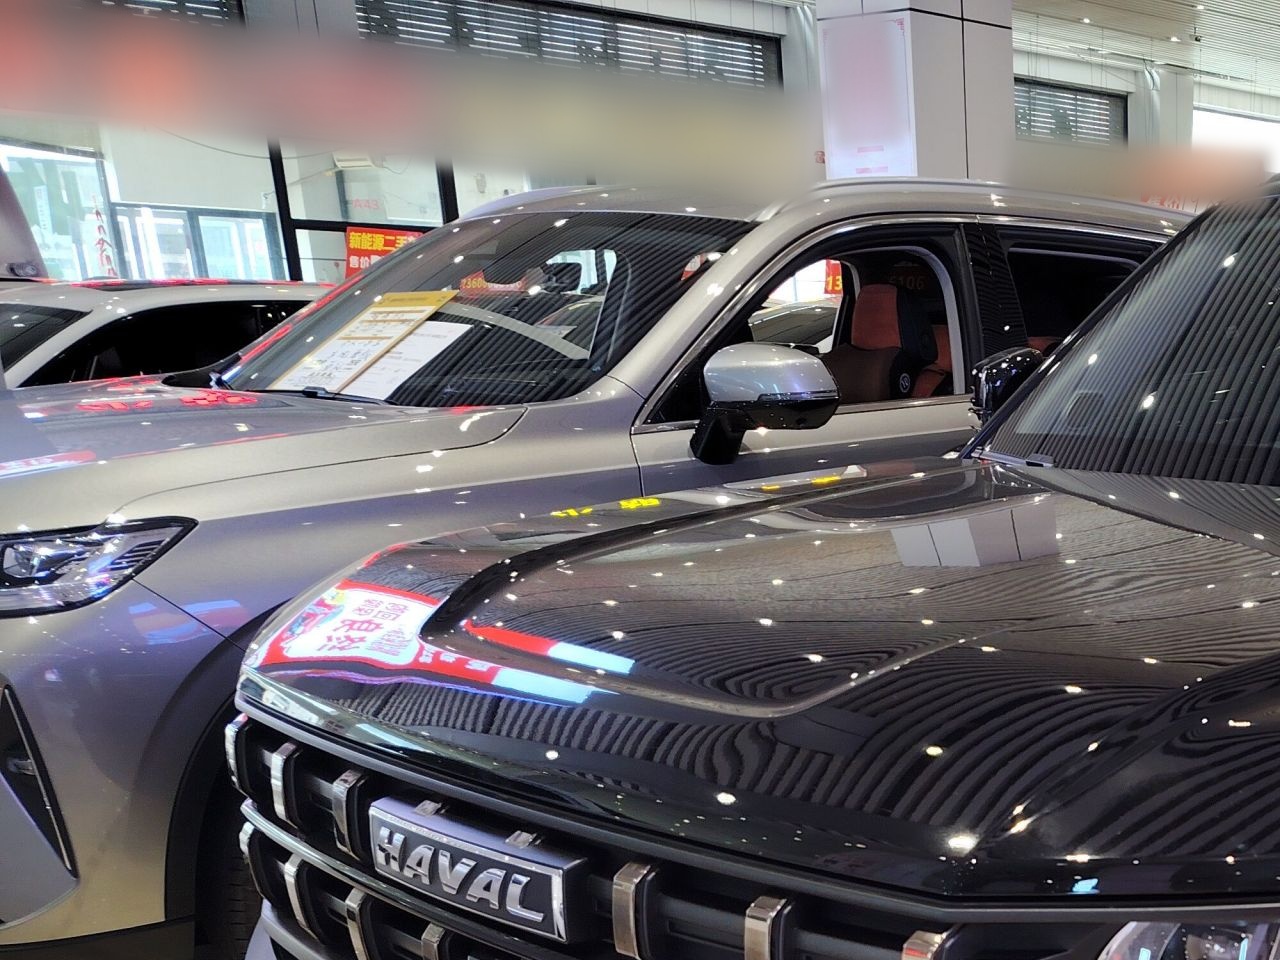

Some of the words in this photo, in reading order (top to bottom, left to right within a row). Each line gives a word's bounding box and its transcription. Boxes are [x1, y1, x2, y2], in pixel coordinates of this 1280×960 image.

[349, 231, 416, 250] 新能源二手
[377, 825, 545, 923] HAVAL
